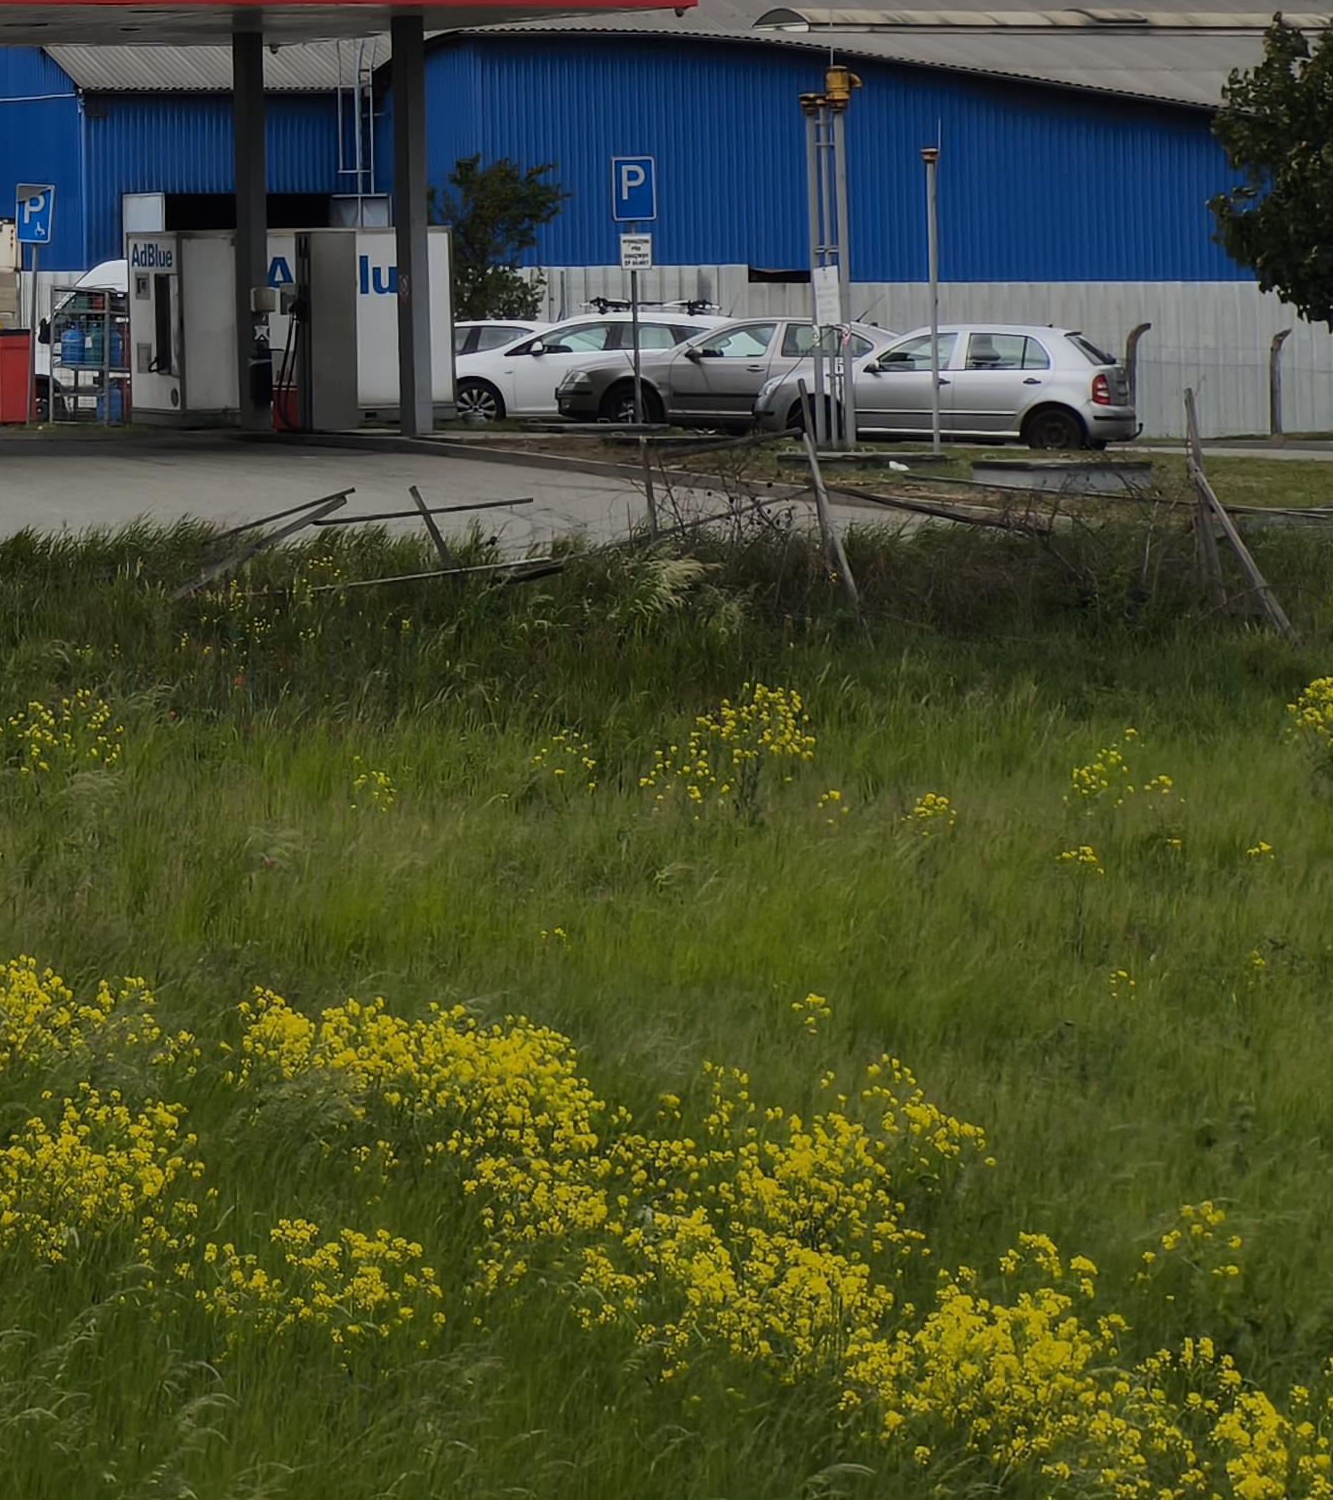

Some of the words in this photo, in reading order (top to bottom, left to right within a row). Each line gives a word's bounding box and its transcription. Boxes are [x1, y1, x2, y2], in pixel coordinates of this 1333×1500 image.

[621, 164, 646, 200] P
[24, 194, 45, 223] P
[131, 243, 173, 268] AdBlue
